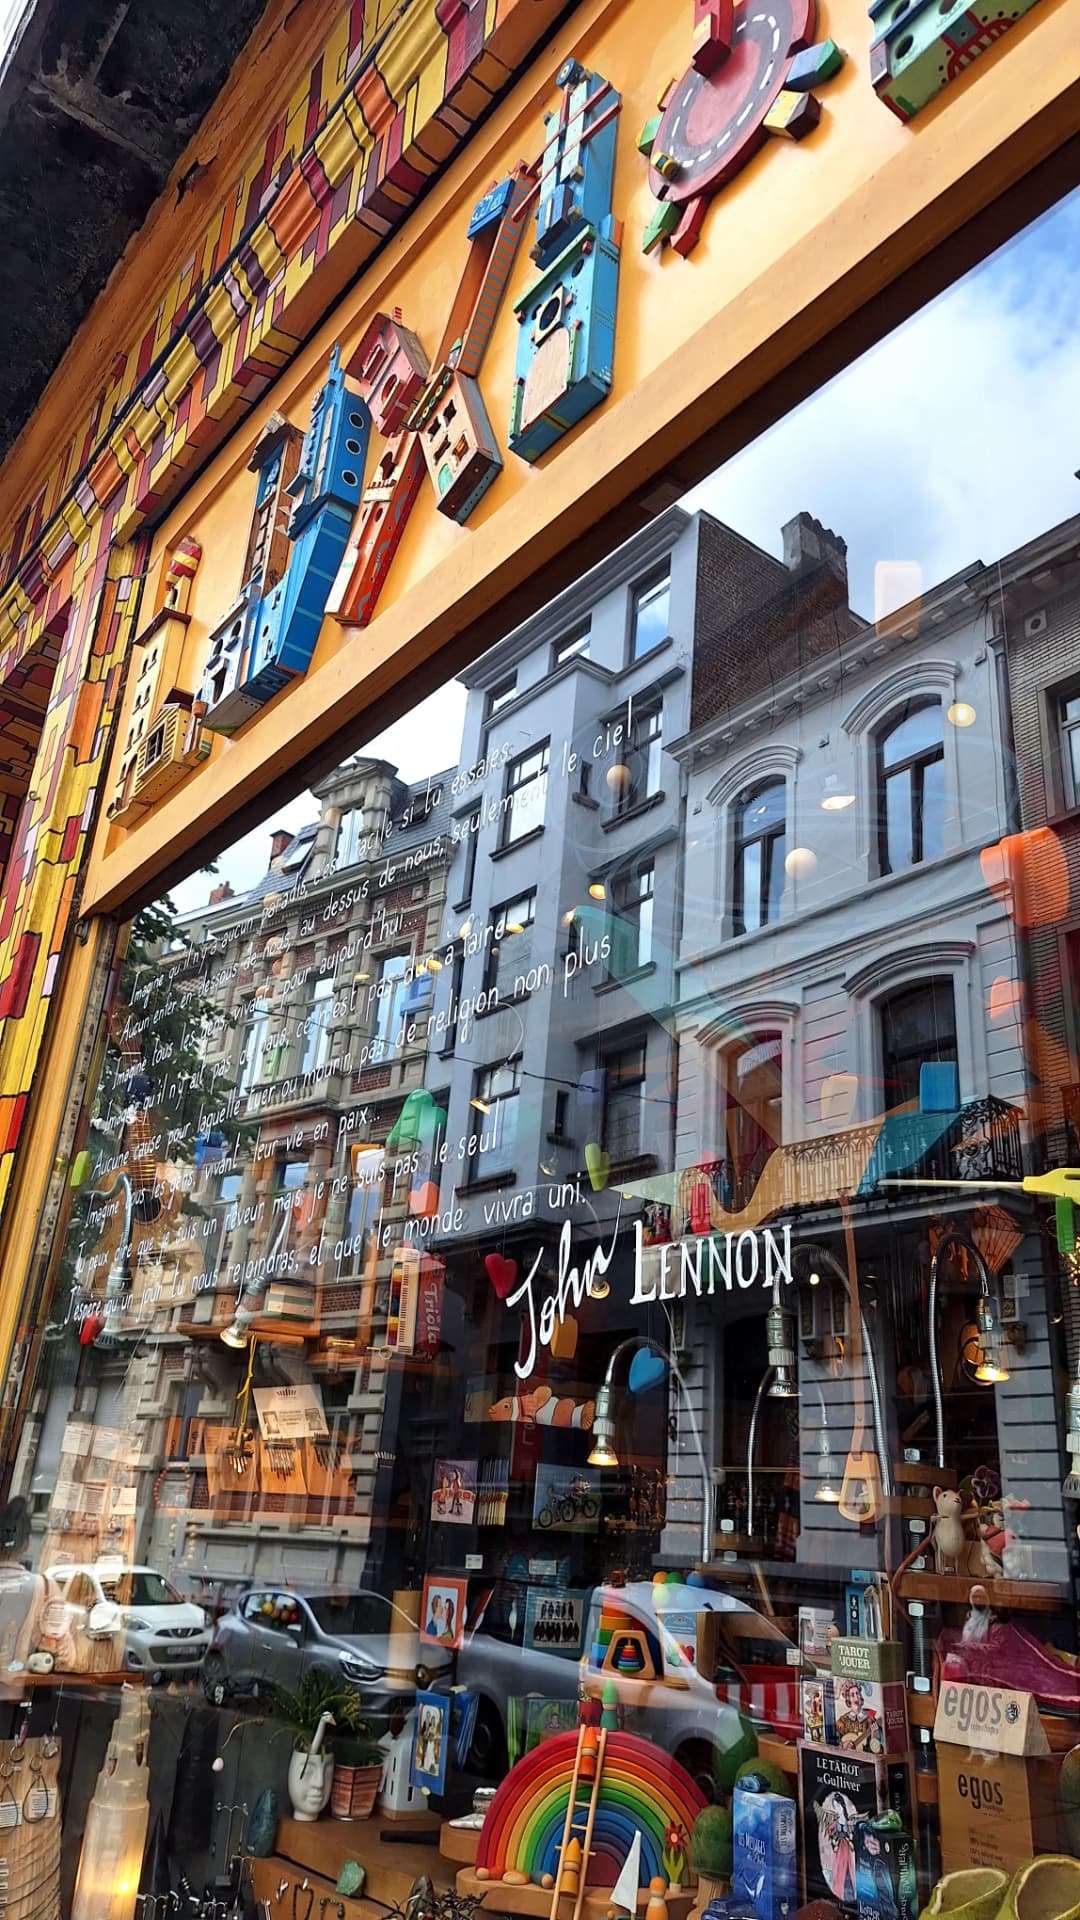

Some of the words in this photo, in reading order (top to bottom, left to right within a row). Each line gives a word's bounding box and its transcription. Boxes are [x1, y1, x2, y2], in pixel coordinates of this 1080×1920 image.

[120, 1014, 150, 1045] Aucun
[180, 992, 193, 1008] en
[199, 962, 238, 997] dessous
[300, 914, 316, 937] au
[323, 879, 369, 921] dessus
[378, 859, 397, 888] de
[404, 836, 444, 872] nous,
[561, 740, 577, 777] le
[592, 695, 633, 758] ciel
[128, 971, 164, 1008] Imagine
[221, 918, 253, 947] aucun
[402, 798, 415, 828] si
[425, 776, 442, 814] tu
[91, 1149, 129, 1178] Aucune
[197, 1087, 241, 1139] laquelle
[247, 1086, 274, 1111] tuer
[282, 1079, 297, 1097] ou
[357, 1036, 385, 1083] pas
[395, 1011, 415, 1048] de
[427, 986, 499, 1044] religion
[514, 963, 550, 996] non
[563, 925, 611, 998] plus
[111, 1056, 147, 1089] Imagine
[152, 1037, 174, 1066] tous
[180, 1022, 196, 1051] les
[281, 966, 312, 1008] pour
[211, 1054, 232, 1094] pas
[296, 1019, 312, 1038] ce
[366, 976, 393, 1021] pas
[462, 912, 505, 958] faire
[84, 1192, 119, 1234] Imagine
[205, 1131, 241, 1178] vivant
[254, 1126, 279, 1164] leur
[286, 1123, 303, 1151] vie
[313, 1115, 329, 1141] en
[337, 1106, 380, 1152] paix...
[137, 1239, 154, 1264] que
[203, 1218, 218, 1236] un
[308, 1173, 324, 1222] je
[332, 1171, 348, 1194] ne
[358, 1162, 386, 1187] suis
[392, 1151, 419, 1195] pas
[434, 1123, 447, 1165] le
[458, 1097, 499, 1158] seul
[172, 1259, 184, 1297] tu
[192, 1271, 218, 1291] nous
[310, 1220, 327, 1266] et
[334, 1232, 362, 1283] que
[377, 1208, 391, 1250] le
[404, 1184, 463, 1240] monde
[484, 1190, 533, 1224] vivra
[548, 1172, 587, 1209] uni.
[506, 1191, 624, 1379] John
[838, 1645, 870, 1658] TAROT
[944, 1685, 1003, 1732] egos
[823, 1773, 861, 1792] Gulliver
[958, 1774, 1003, 1809] egos
